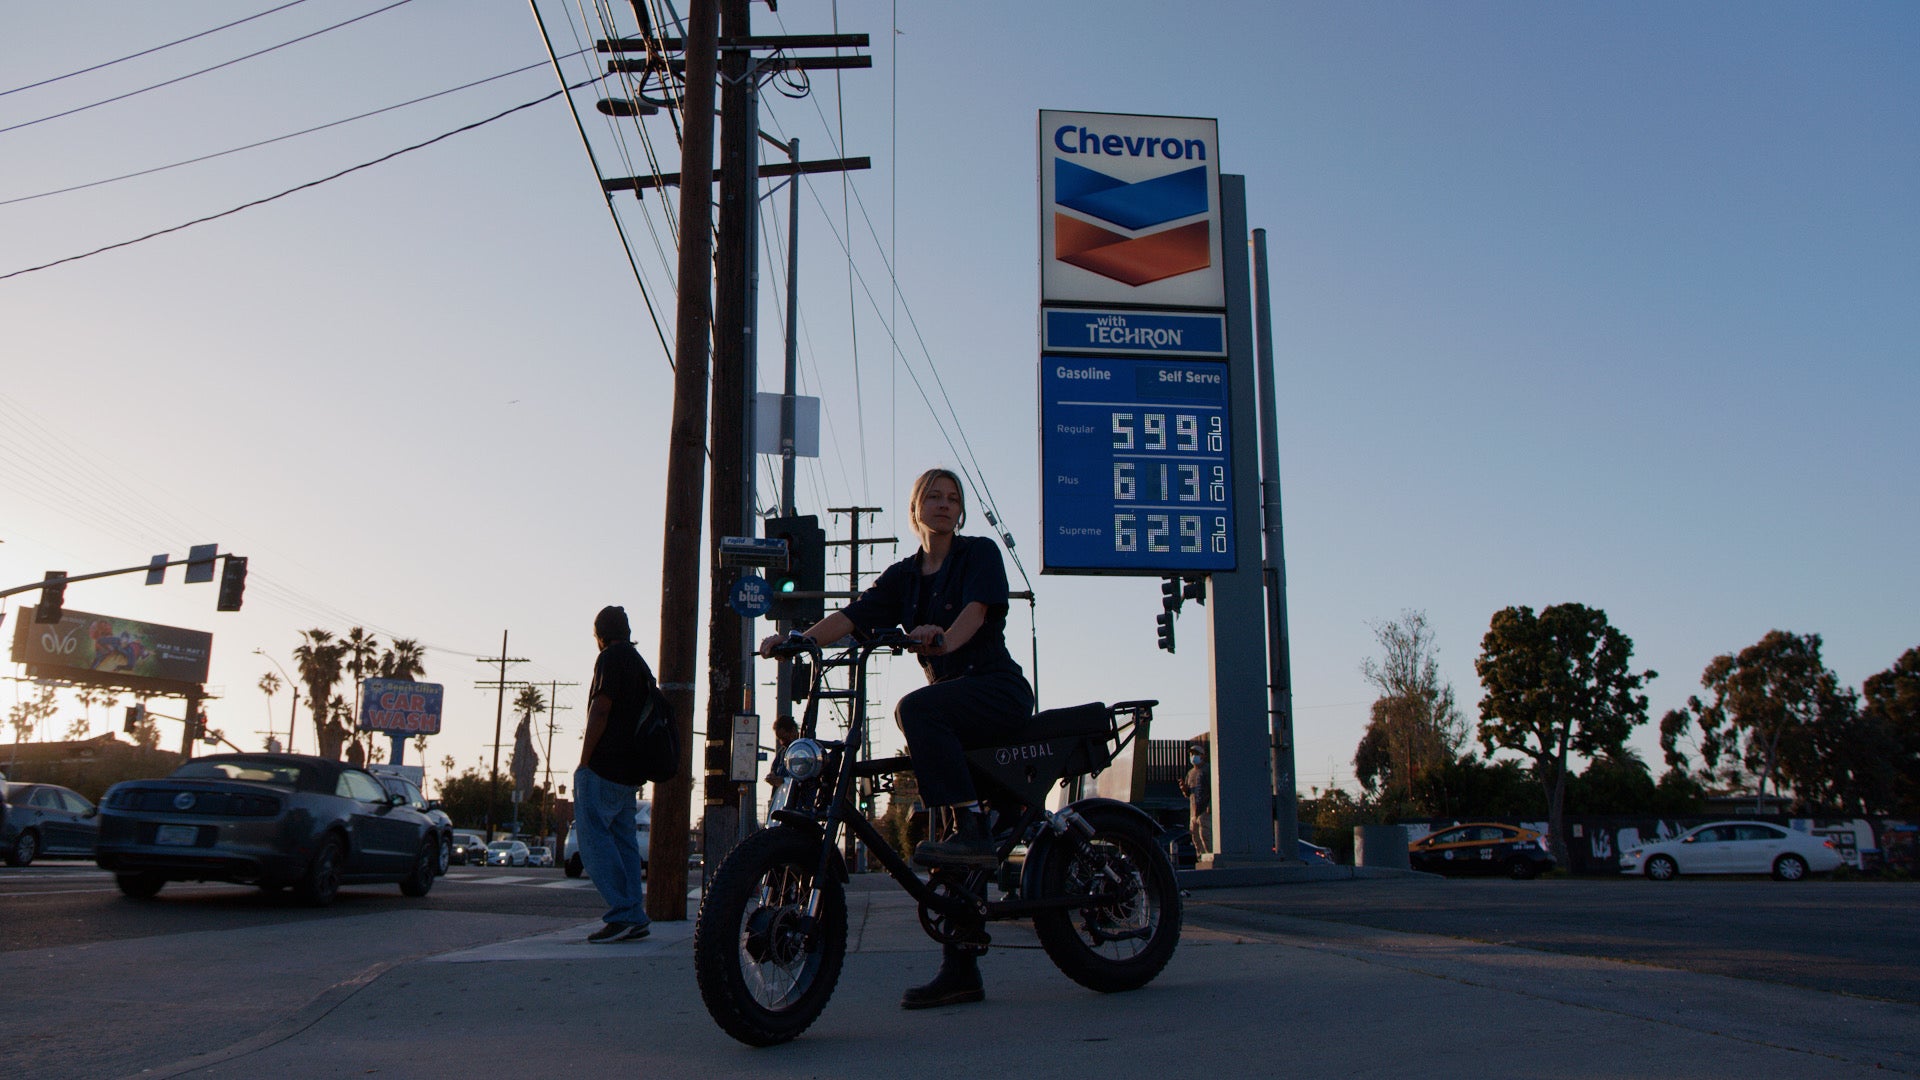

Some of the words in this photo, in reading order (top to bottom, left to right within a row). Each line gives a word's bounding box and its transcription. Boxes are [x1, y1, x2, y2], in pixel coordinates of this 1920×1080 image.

[1054, 125, 1206, 160] Chevron
[1097, 315, 1126, 327] with
[1085, 323, 1182, 348] TECHRON
[1056, 366, 1111, 380] Gasoline
[1158, 370, 1182, 383] Self
[1186, 371, 1221, 384] Serve
[1057, 424, 1095, 436] Regular
[1112, 412, 1199, 451] 599
[1058, 476, 1079, 485] Plus
[1113, 462, 1201, 502] 613
[1059, 526, 1102, 537] Supreme
[1114, 513, 1203, 553] 629
[738, 590, 765, 602] blue
[744, 582, 760, 592] big
[380, 692, 426, 713] CAR
[368, 709, 437, 732] WASH
[1011, 743, 1054, 761] PEDAL
